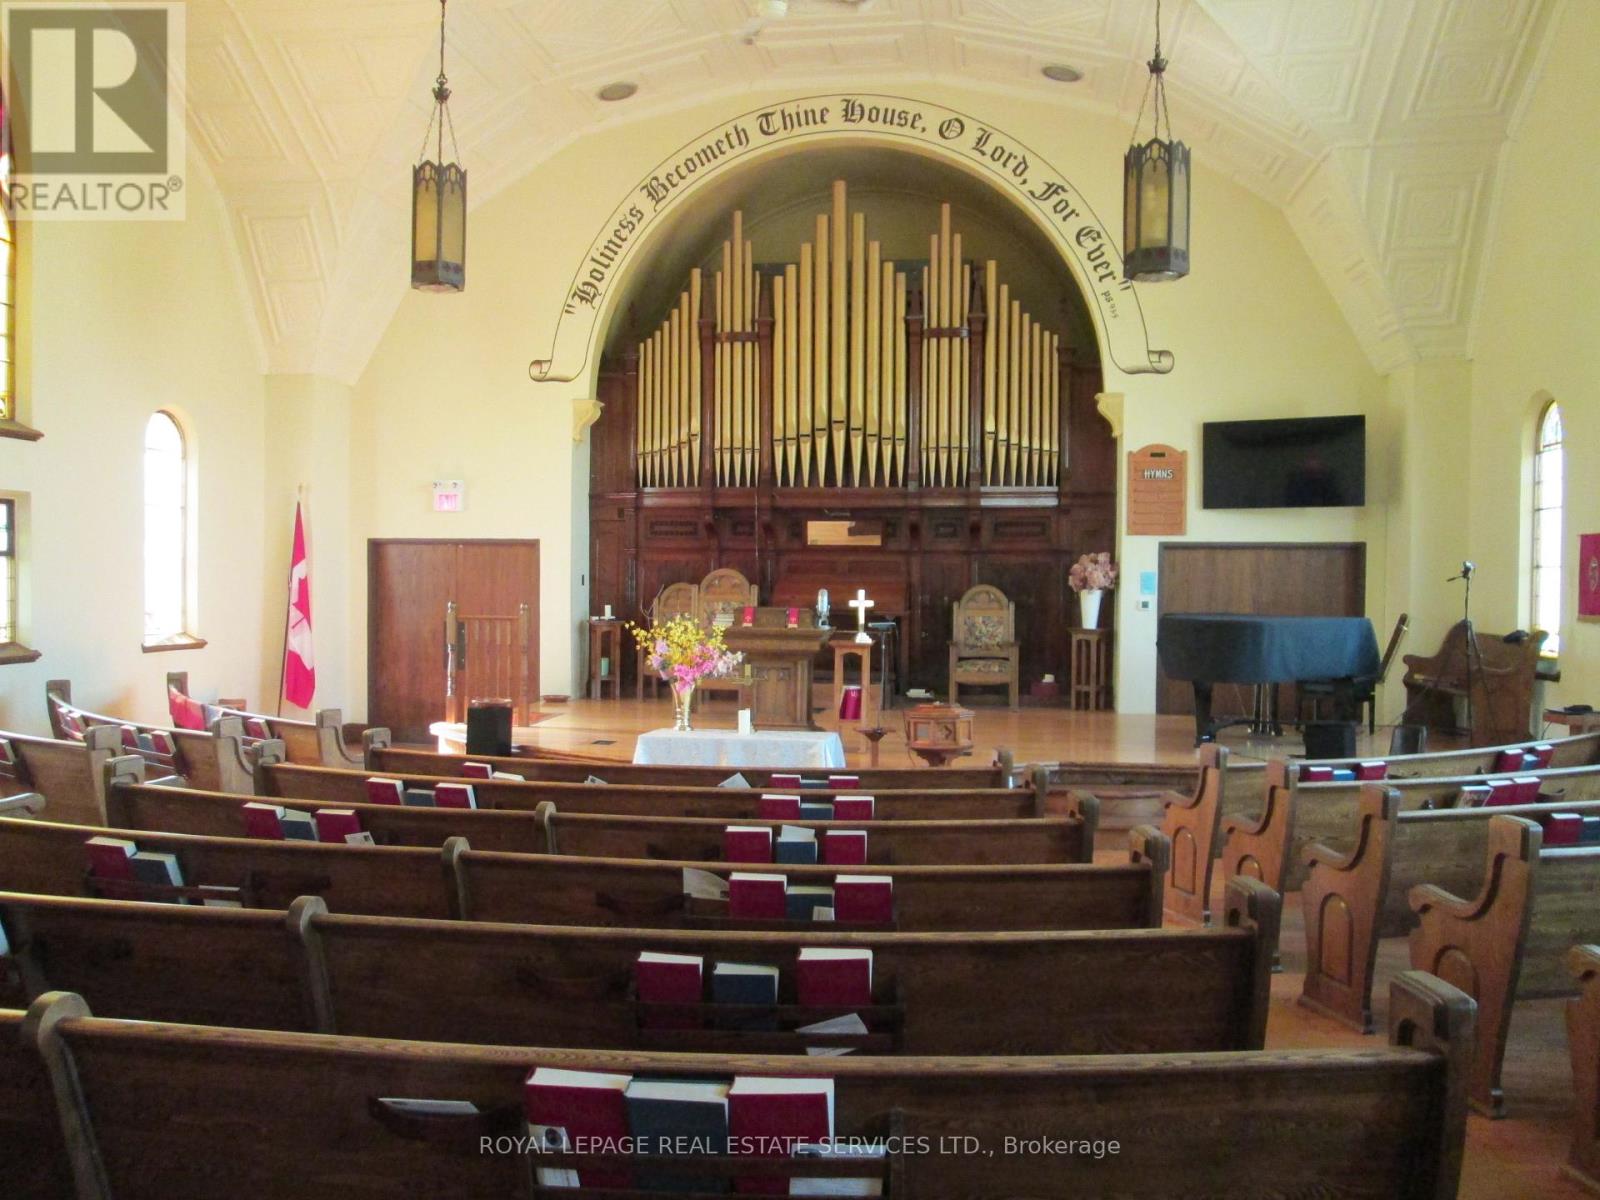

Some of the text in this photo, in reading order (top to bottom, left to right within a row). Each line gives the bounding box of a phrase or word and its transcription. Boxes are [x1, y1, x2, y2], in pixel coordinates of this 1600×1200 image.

[640, 124, 750, 213] Becometh
[756, 103, 831, 137] Thine
[840, 98, 927, 134] House,
[938, 117, 965, 140] O
[971, 127, 1030, 186] Lord,
[1028, 181, 1081, 222] For
[1143, 468, 1174, 480] HYMNS
